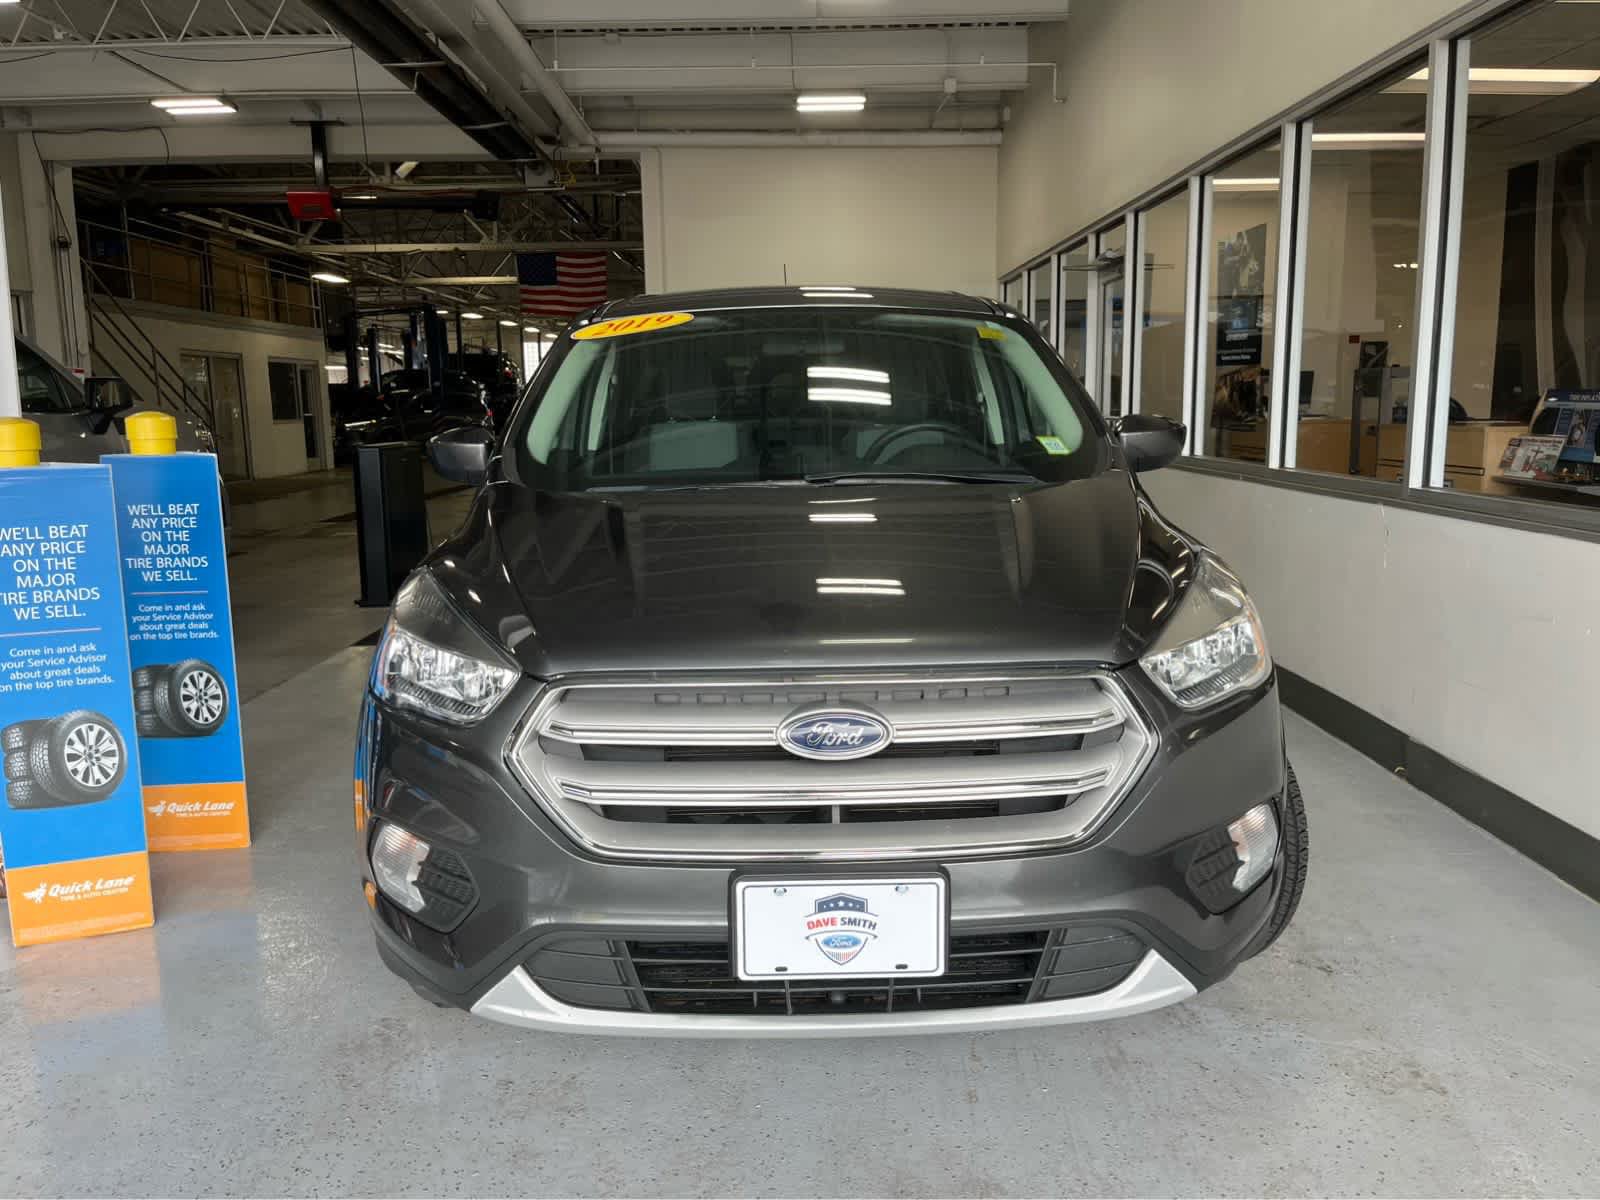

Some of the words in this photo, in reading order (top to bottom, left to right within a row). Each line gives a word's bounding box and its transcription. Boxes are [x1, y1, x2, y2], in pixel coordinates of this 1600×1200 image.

[590, 314, 675, 337] 2019
[127, 503, 165, 516] WE'LL
[168, 503, 200, 515] BEAT
[131, 517, 158, 529] ANY
[162, 516, 198, 528] PRICE
[0, 526, 45, 541] WE'LL
[48, 524, 89, 539] BEAT
[141, 530, 161, 542] ON
[164, 530, 191, 542] THE
[0, 542, 36, 557] ANY
[40, 540, 87, 556] PRICE
[144, 543, 190, 555] MAJOR
[13, 558, 40, 573] ON
[44, 556, 78, 571] THE
[125, 557, 153, 569] TIRE
[156, 555, 209, 568] BRANDS
[16, 572, 76, 589] MAJOR
[141, 570, 162, 582] WE
[165, 569, 198, 581] SELL.
[33, 586, 101, 604] BRANDS
[13, 606, 41, 621] WE
[44, 603, 87, 619] SELL.
[138, 604, 163, 613] Come
[164, 603, 173, 612] in
[174, 603, 190, 611] and
[192, 602, 206, 611] ask
[132, 614, 151, 623] your
[152, 612, 182, 621] Service
[183, 612, 214, 621] Advisor
[139, 622, 164, 631] about
[165, 622, 187, 632] great
[187, 620, 209, 630] deals
[129, 633, 142, 641] on
[143, 631, 157, 640] the
[158, 631, 173, 641] top
[174, 630, 188, 640] tire
[9, 647, 41, 658] Come
[43, 645, 54, 656] in
[56, 643, 77, 655] and
[79, 642, 97, 653] ask
[1, 660, 25, 672] your
[27, 657, 66, 668] Service
[68, 653, 107, 665] Advisor
[9, 670, 41, 681] about
[43, 667, 72, 680] great
[73, 664, 102, 676] deals
[0, 683, 13, 693] on
[15, 681, 33, 692] the
[36, 679, 55, 691] top
[56, 677, 74, 688] tire
[76, 673, 114, 686] brands.
[806, 721, 865, 746] Ford
[167, 801, 202, 814] Quick
[203, 800, 235, 812] Lane
[48, 879, 94, 897] Quick
[95, 875, 136, 891] Lane
[806, 916, 838, 930] DAVE
[840, 916, 877, 931] SMITH
